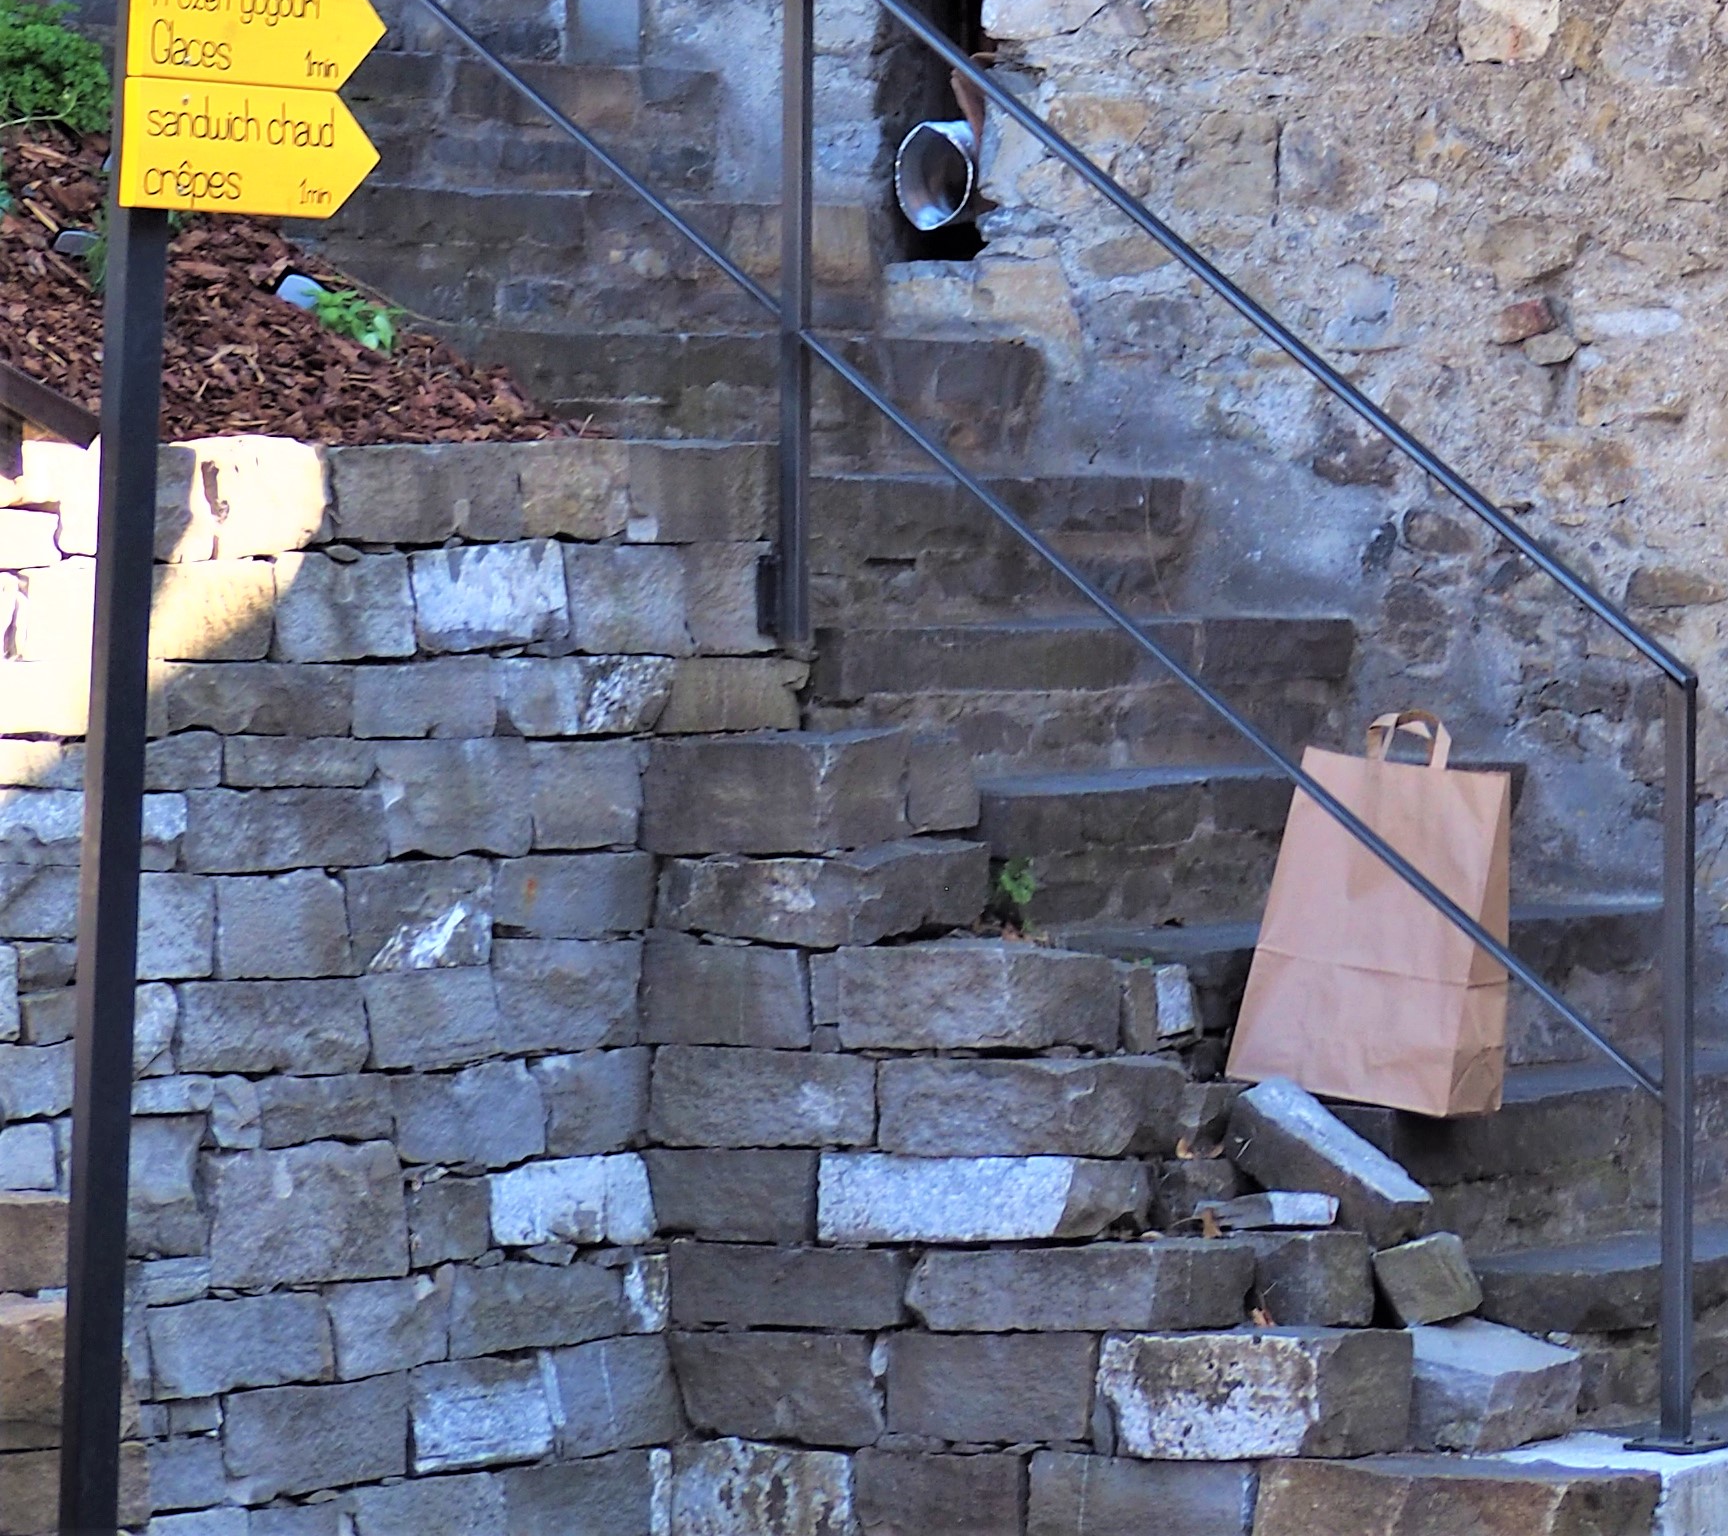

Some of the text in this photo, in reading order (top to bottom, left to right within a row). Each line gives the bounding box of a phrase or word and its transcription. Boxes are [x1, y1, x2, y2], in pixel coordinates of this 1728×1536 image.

[150, 18, 233, 71] Glaces
[146, 95, 335, 149] sandwich chaud
[143, 160, 242, 208] crêpes
